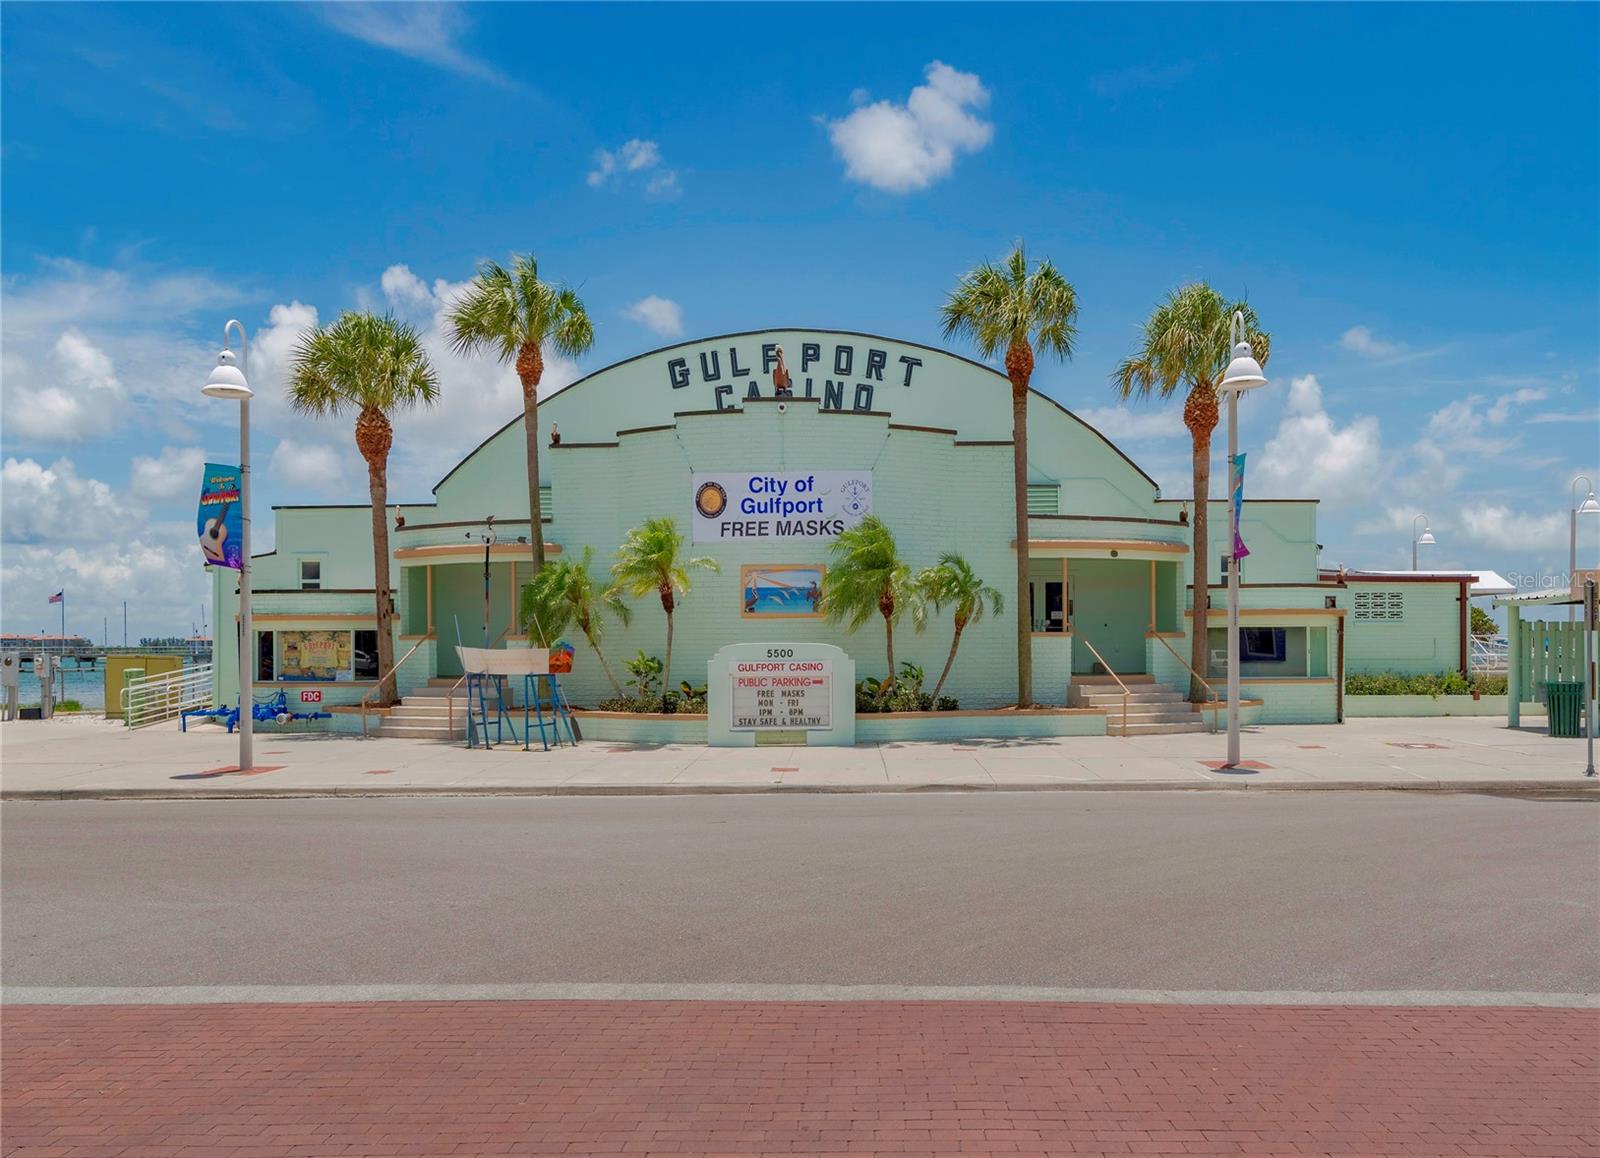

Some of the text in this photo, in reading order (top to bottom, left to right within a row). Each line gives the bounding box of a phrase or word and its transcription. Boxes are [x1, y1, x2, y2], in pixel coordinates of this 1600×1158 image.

[667, 343, 923, 389] GULFPORT
[748, 476, 814, 496] City of
[741, 497, 823, 517] Gulfport
[720, 520, 845, 537] FREE MASKS
[767, 649, 794, 658] 5500
[737, 662, 824, 672] GULFPORT CASINO
[738, 677, 811, 687] PUBLIC PARKING
[303, 692, 320, 701] FDC
[757, 690, 805, 698] FREE MASKS
[758, 699, 774, 707] MON
[787, 699, 800, 707] FRI
[759, 708, 773, 716] 1PM
[739, 718, 756, 726] STAY
[790, 717, 821, 725] HEALTHY
